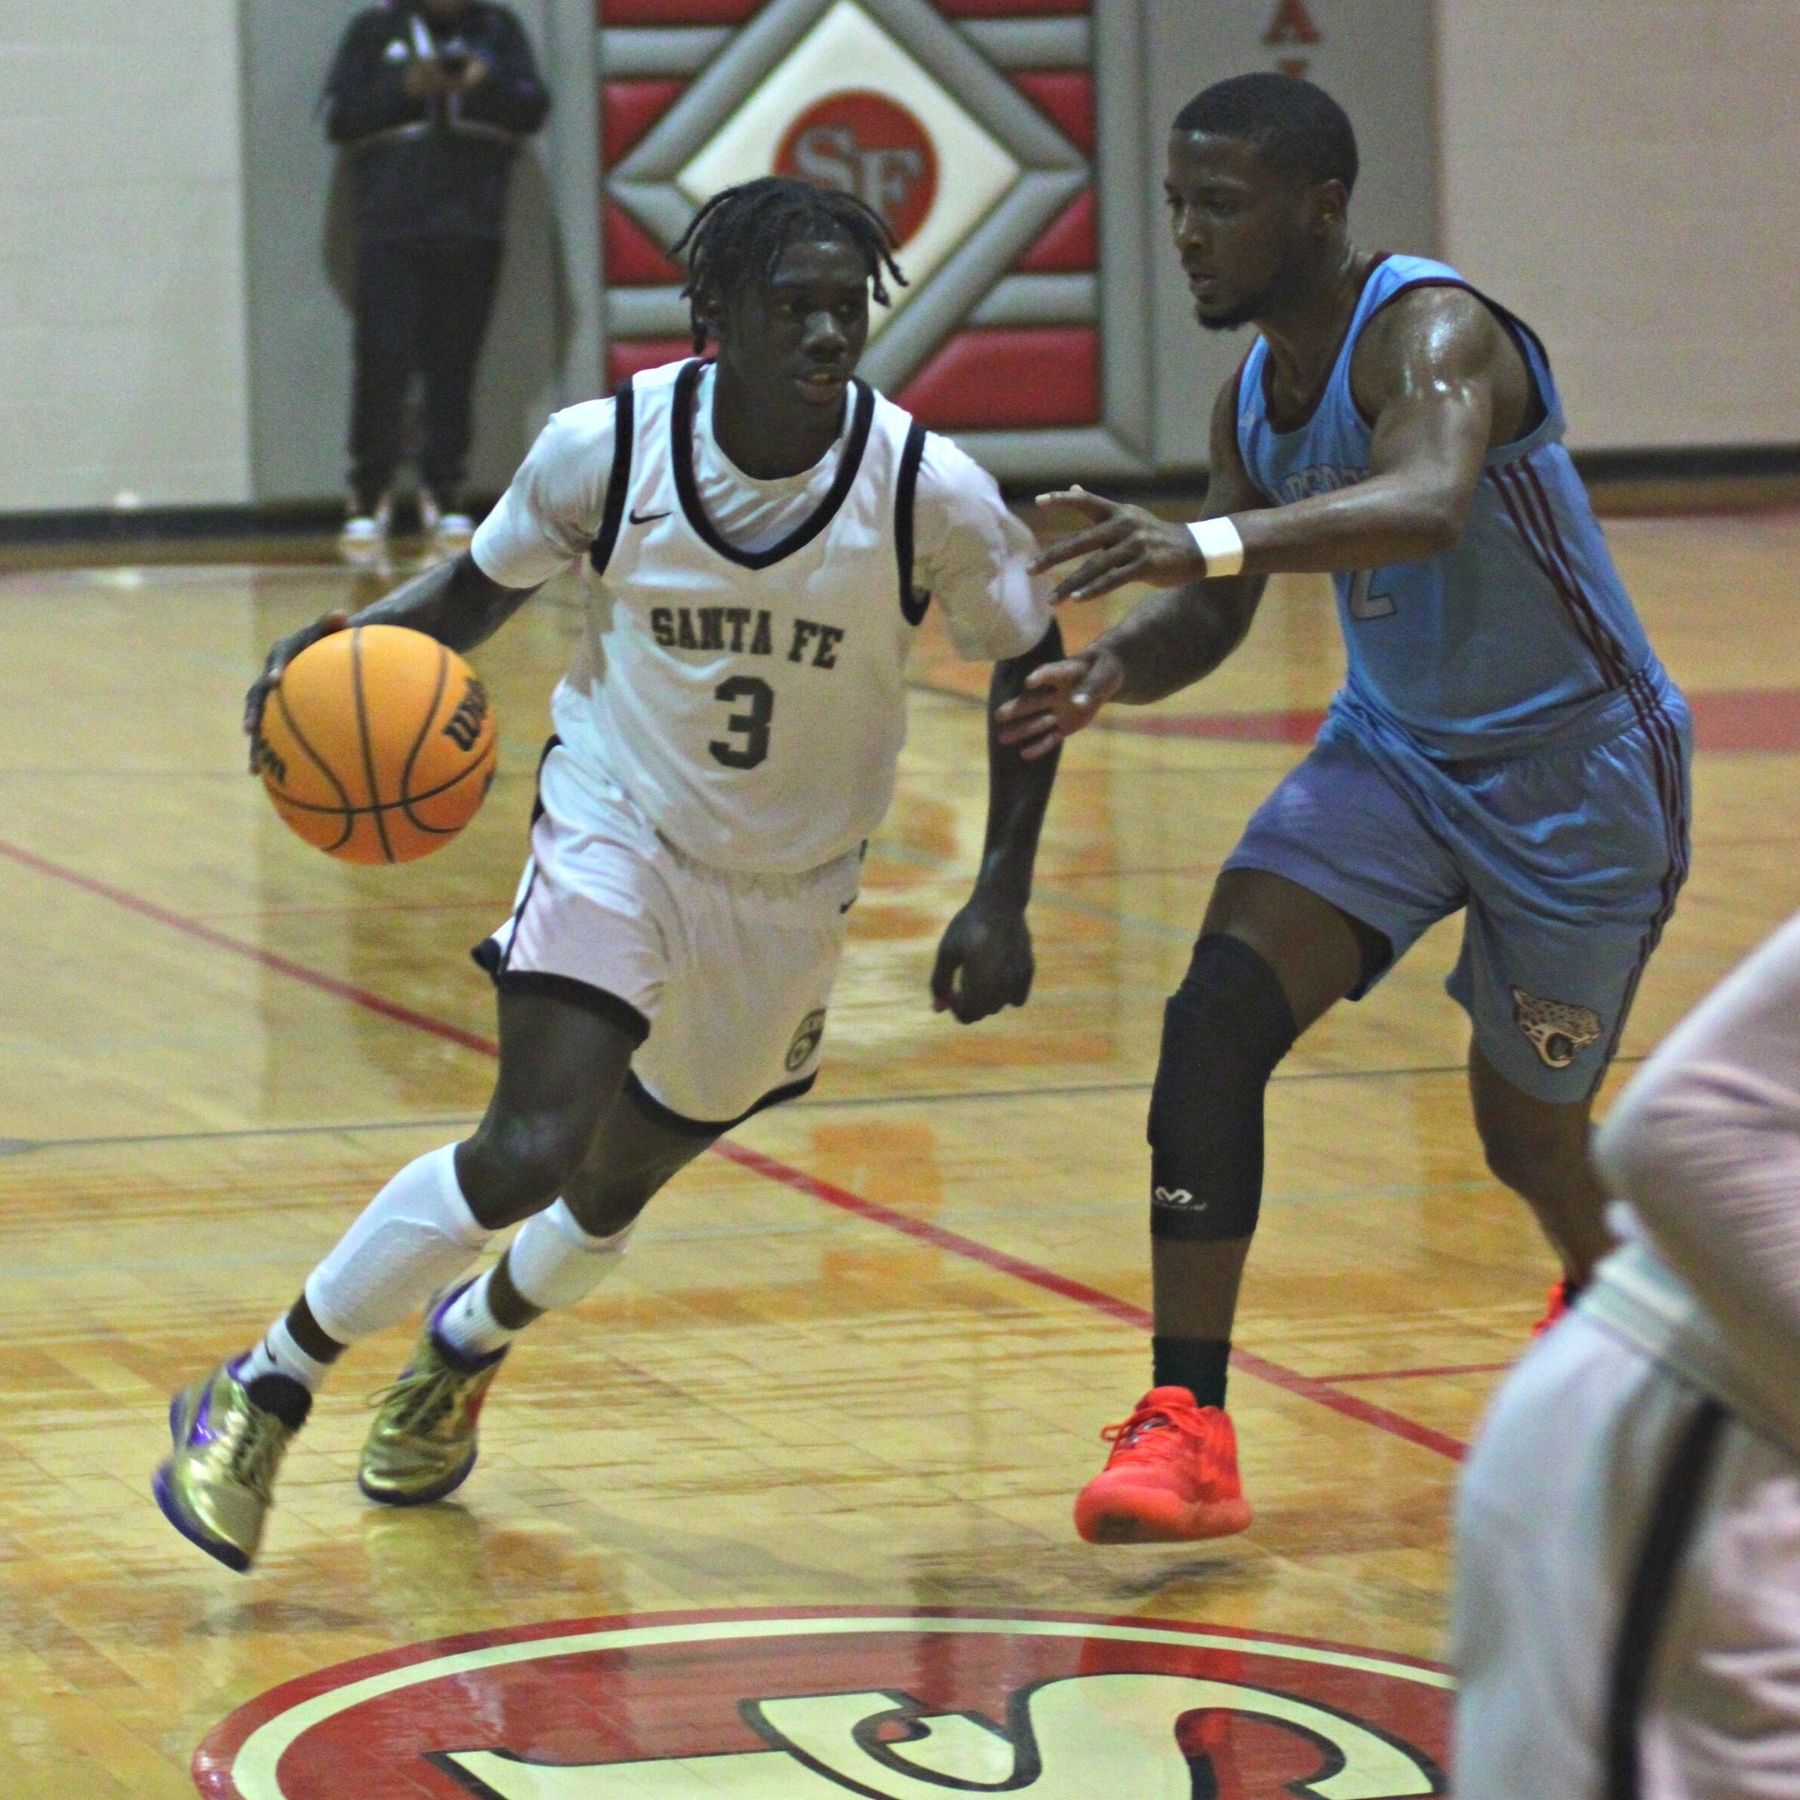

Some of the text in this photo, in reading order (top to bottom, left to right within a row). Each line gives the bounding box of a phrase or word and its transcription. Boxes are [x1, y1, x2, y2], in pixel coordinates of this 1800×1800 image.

[650, 606, 845, 670] SANTA FE
[708, 675, 775, 771] 3
